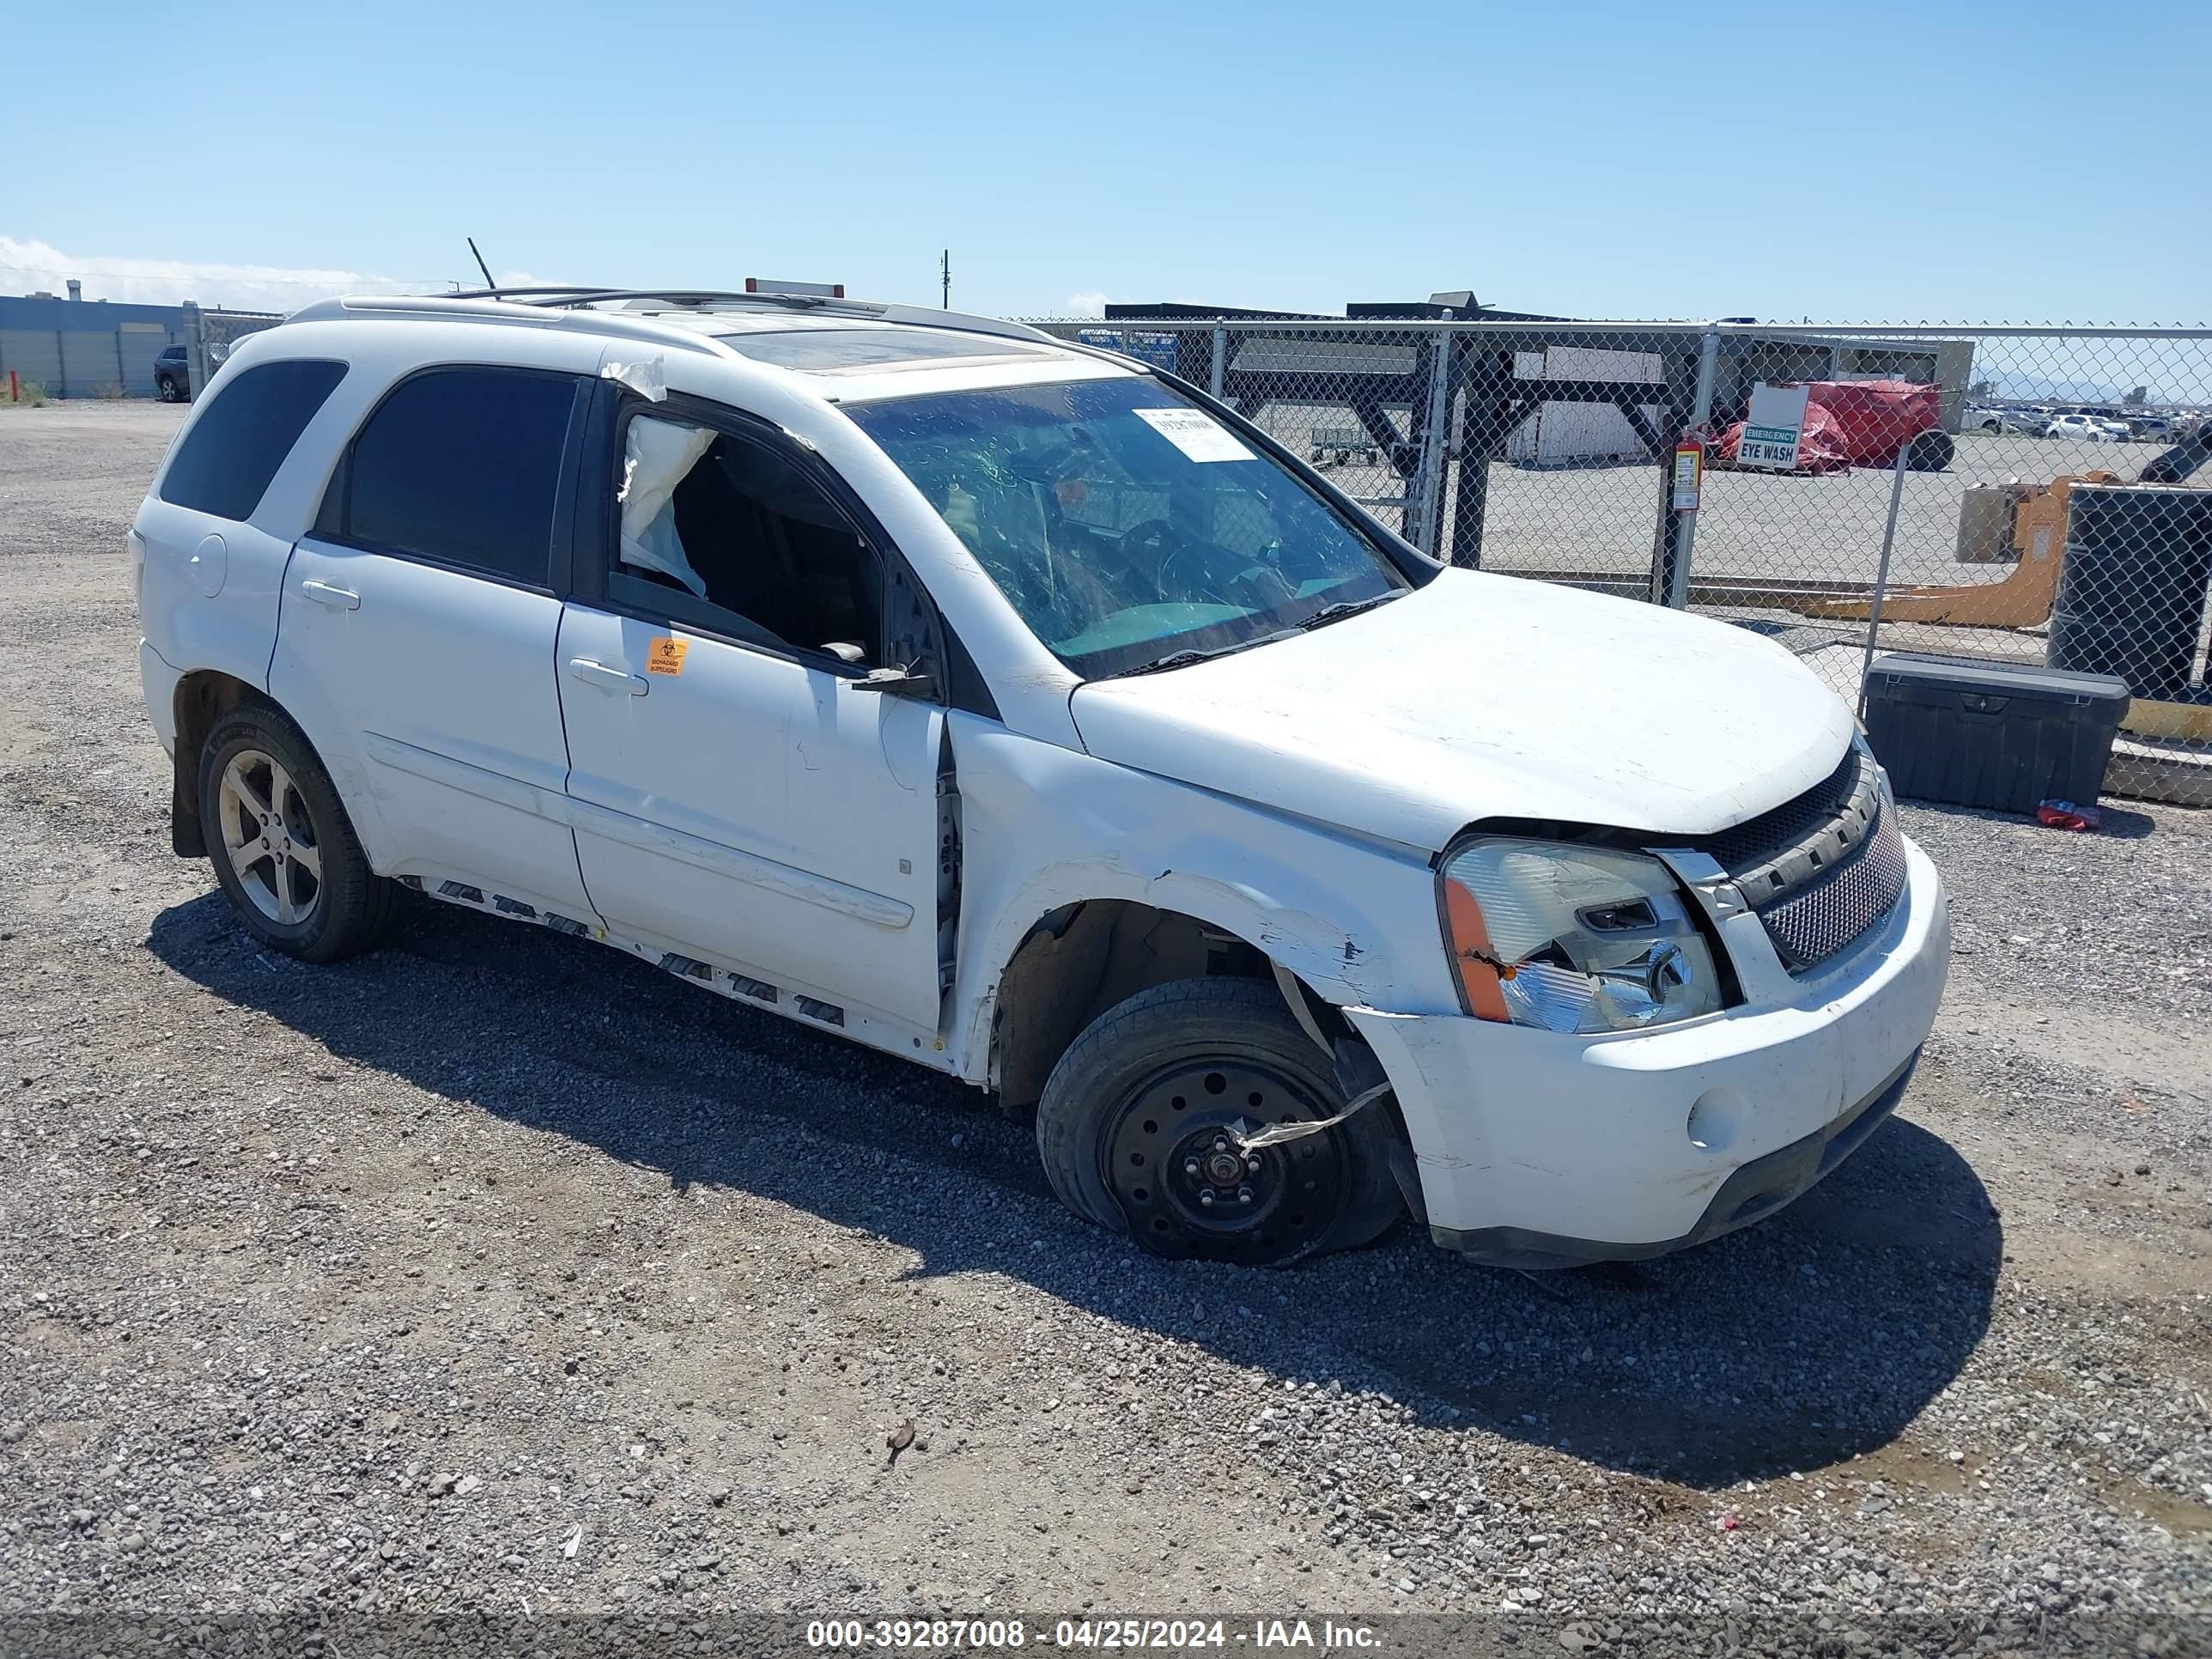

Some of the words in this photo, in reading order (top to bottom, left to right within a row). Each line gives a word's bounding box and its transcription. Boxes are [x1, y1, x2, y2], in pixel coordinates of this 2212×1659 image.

[1746, 430, 1796, 441] EMERGENCY
[1741, 443, 1761, 459] EYE
[1764, 445, 1794, 462] WASH
[652, 659, 679, 667] BIOHAZARD
